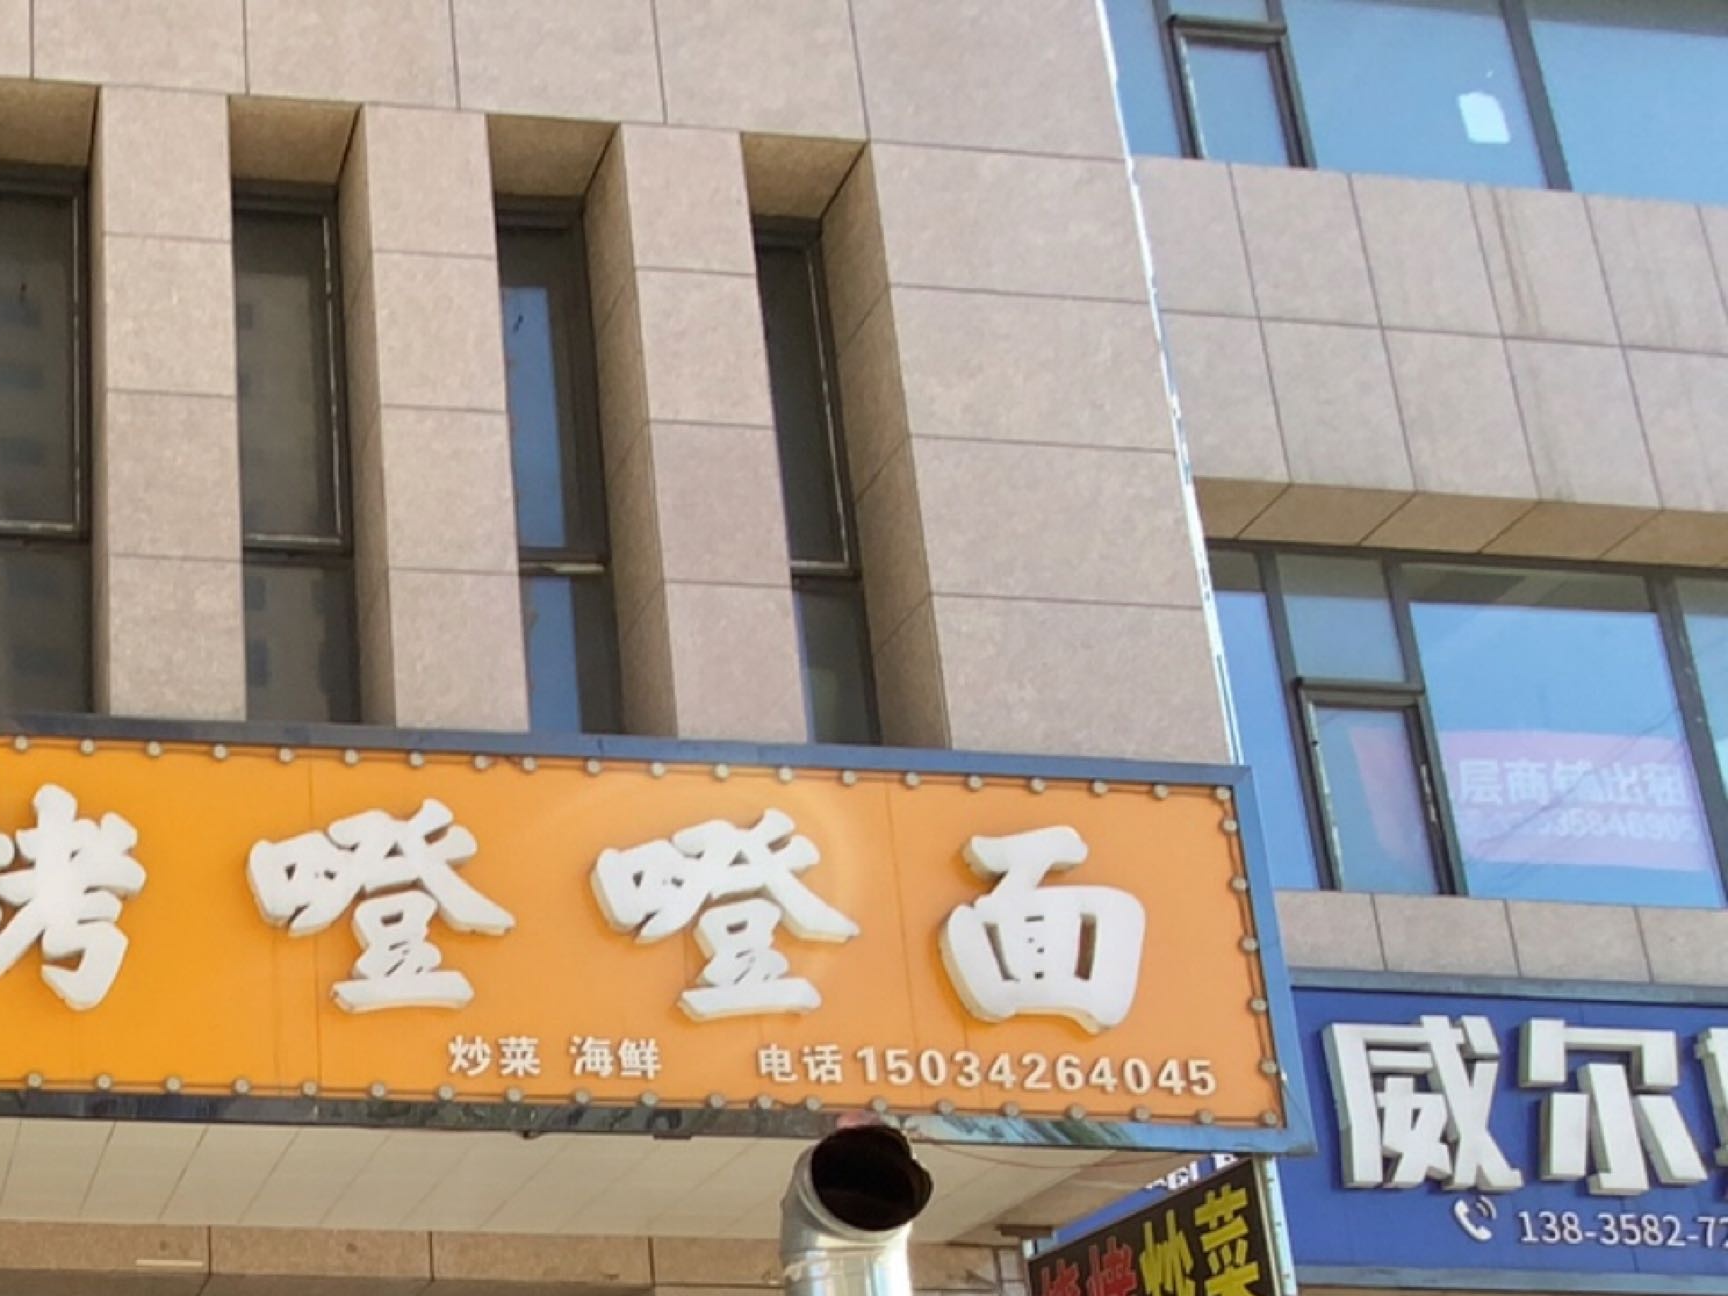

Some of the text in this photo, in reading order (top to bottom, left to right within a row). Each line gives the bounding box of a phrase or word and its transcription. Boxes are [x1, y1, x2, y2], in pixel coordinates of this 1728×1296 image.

[448, 1035, 541, 1077] 炒菜
[569, 1035, 663, 1080] 海鲜
[1322, 1014, 1728, 1196] 威尔
